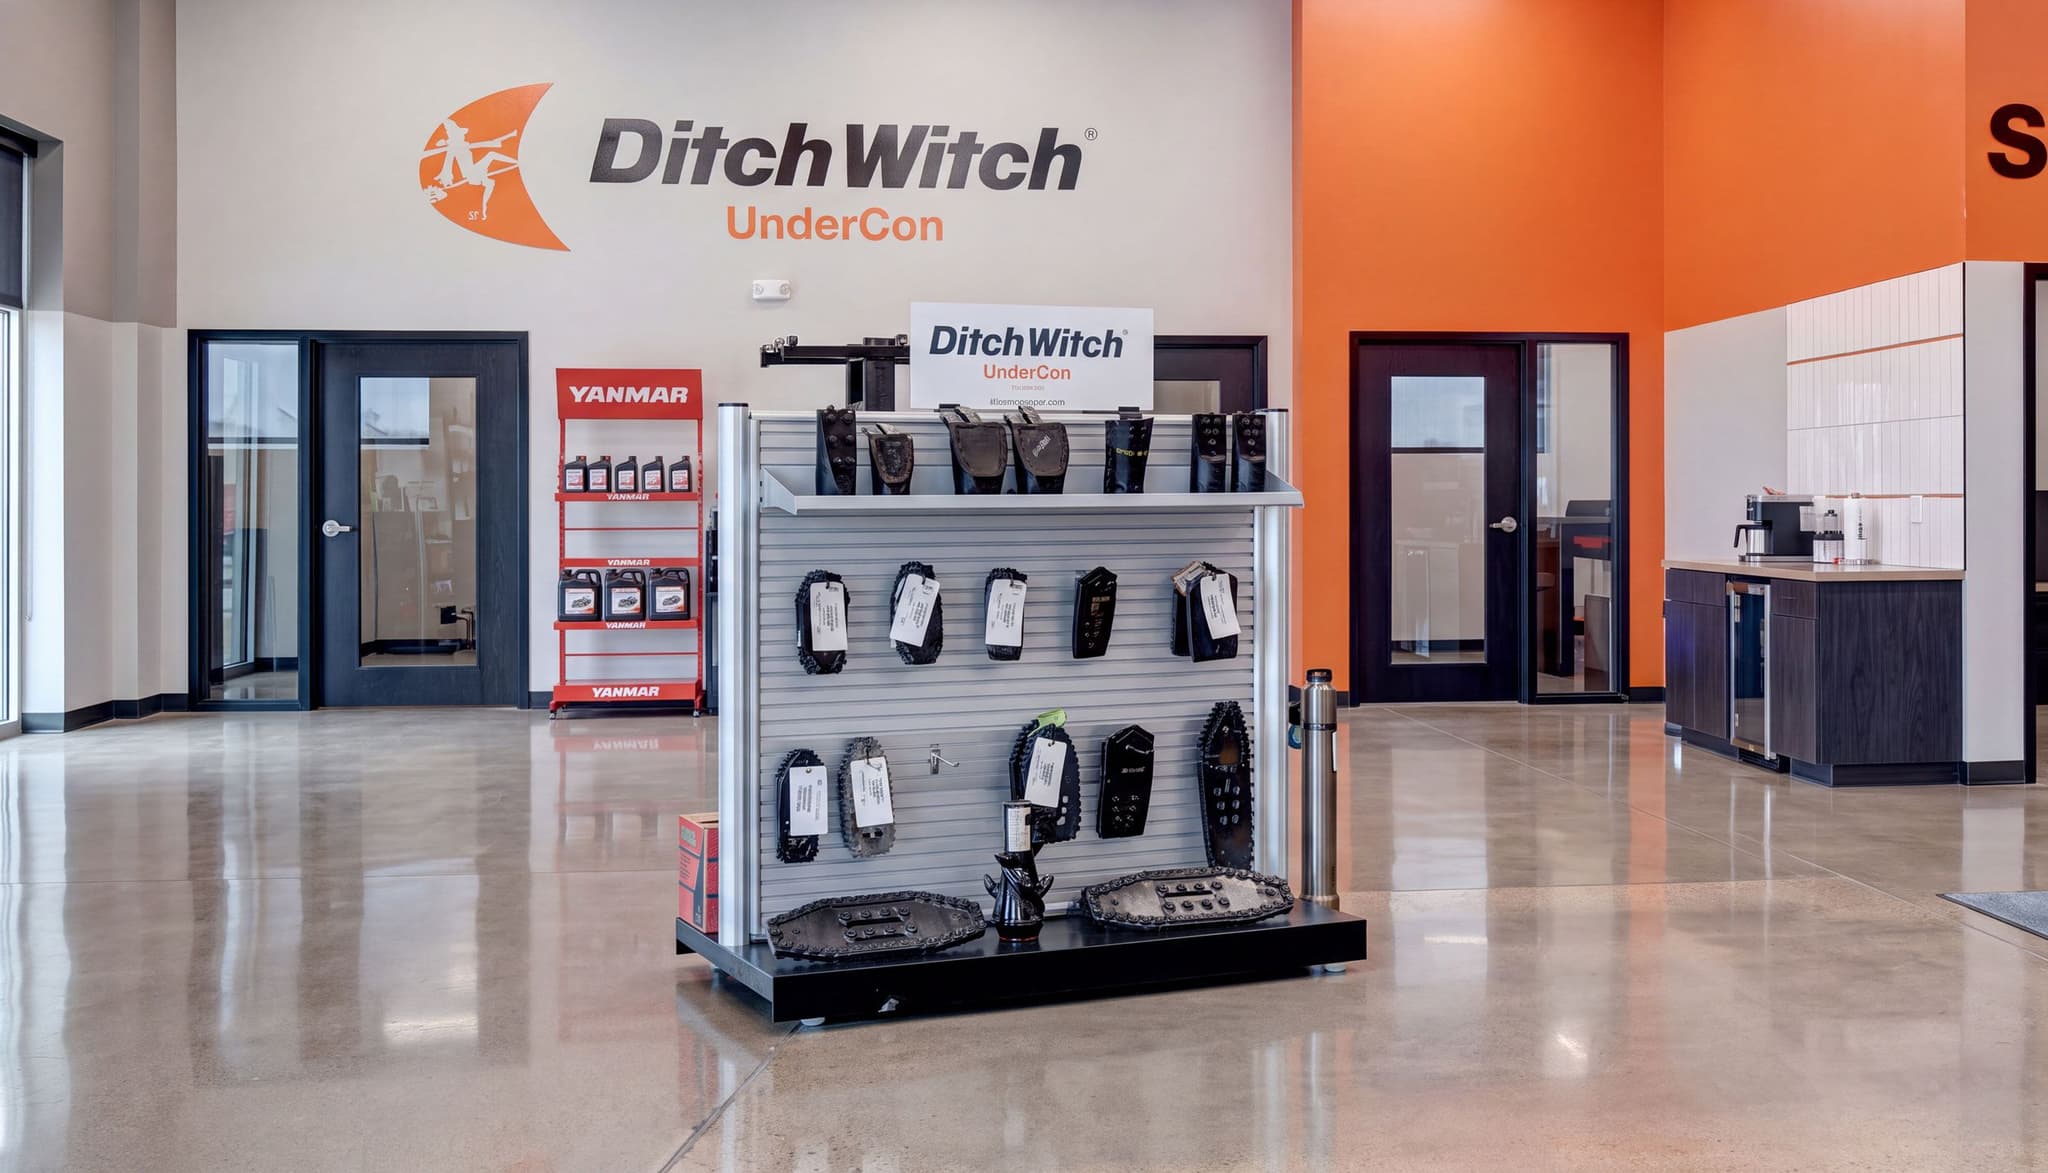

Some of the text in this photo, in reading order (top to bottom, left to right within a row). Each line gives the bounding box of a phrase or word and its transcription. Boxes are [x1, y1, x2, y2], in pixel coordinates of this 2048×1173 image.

[1987, 103, 2047, 179] S
[589, 117, 833, 187] Ditch
[726, 205, 944, 242] UnderCon
[929, 325, 1023, 356] Ditch
[983, 364, 1072, 380] UnderCon
[569, 386, 689, 404] YANMAR
[606, 493, 650, 501] YANMAR
[607, 559, 651, 567] YANMAR
[605, 622, 647, 630] YANMAR
[592, 686, 660, 698] YANMAR
